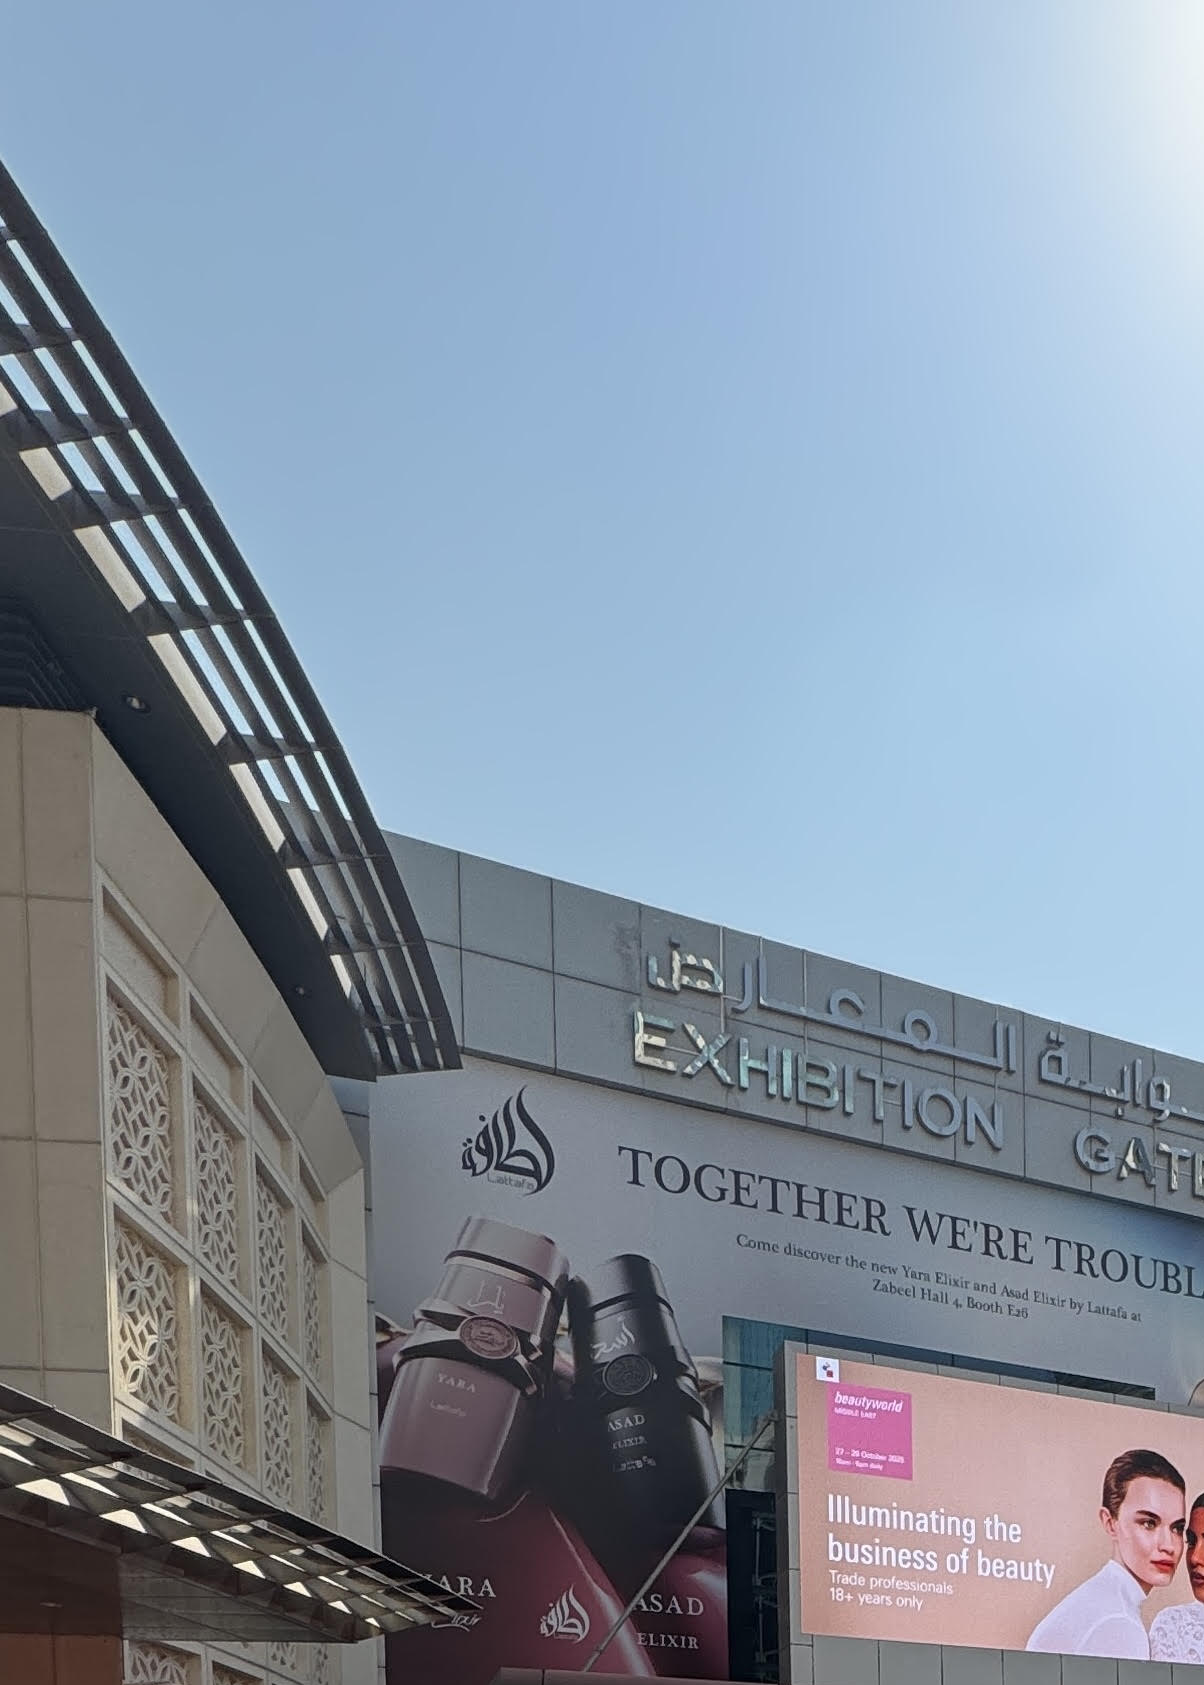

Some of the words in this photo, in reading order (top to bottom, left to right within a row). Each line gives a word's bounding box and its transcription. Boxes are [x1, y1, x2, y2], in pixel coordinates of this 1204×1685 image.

[633, 1009, 1003, 1152] EXHIBITION
[617, 1145, 892, 1237] TOGETHER
[901, 1205, 1034, 1265] WE'RE
[736, 1233, 780, 1254] Come
[783, 1242, 842, 1266] discover
[845, 1255, 867, 1271] the
[871, 1262, 898, 1276] new
[901, 1264, 931, 1283] Yara
[935, 1271, 970, 1290] Elixir
[973, 1280, 997, 1296] and
[1001, 1284, 1030, 1302] Asad
[1033, 1290, 1067, 1309] Elixir
[1069, 1297, 1084, 1316] by
[1087, 1301, 1128, 1321] Lattafa
[1130, 1311, 1143, 1323] at
[872, 1278, 917, 1299] Zabeel
[920, 1287, 950, 1305] Hall
[966, 1297, 1003, 1316] Booth
[437, 1372, 477, 1393] YARA
[834, 1391, 904, 1413] beautyworld
[608, 1414, 646, 1433] ASAD
[828, 1493, 977, 1545] Illuminating
[983, 1513, 1023, 1543] the
[828, 1532, 938, 1572] business
[946, 1547, 969, 1574] of
[977, 1549, 1057, 1589] beauty
[422, 1573, 497, 1599] ARA
[828, 1569, 866, 1587] Trade
[869, 1575, 954, 1595] professionals
[633, 1593, 704, 1616] ASAD
[829, 1587, 854, 1602] 18+
[858, 1591, 893, 1607] years
[896, 1594, 924, 1612] only
[636, 1631, 700, 1650] ELIXIR
